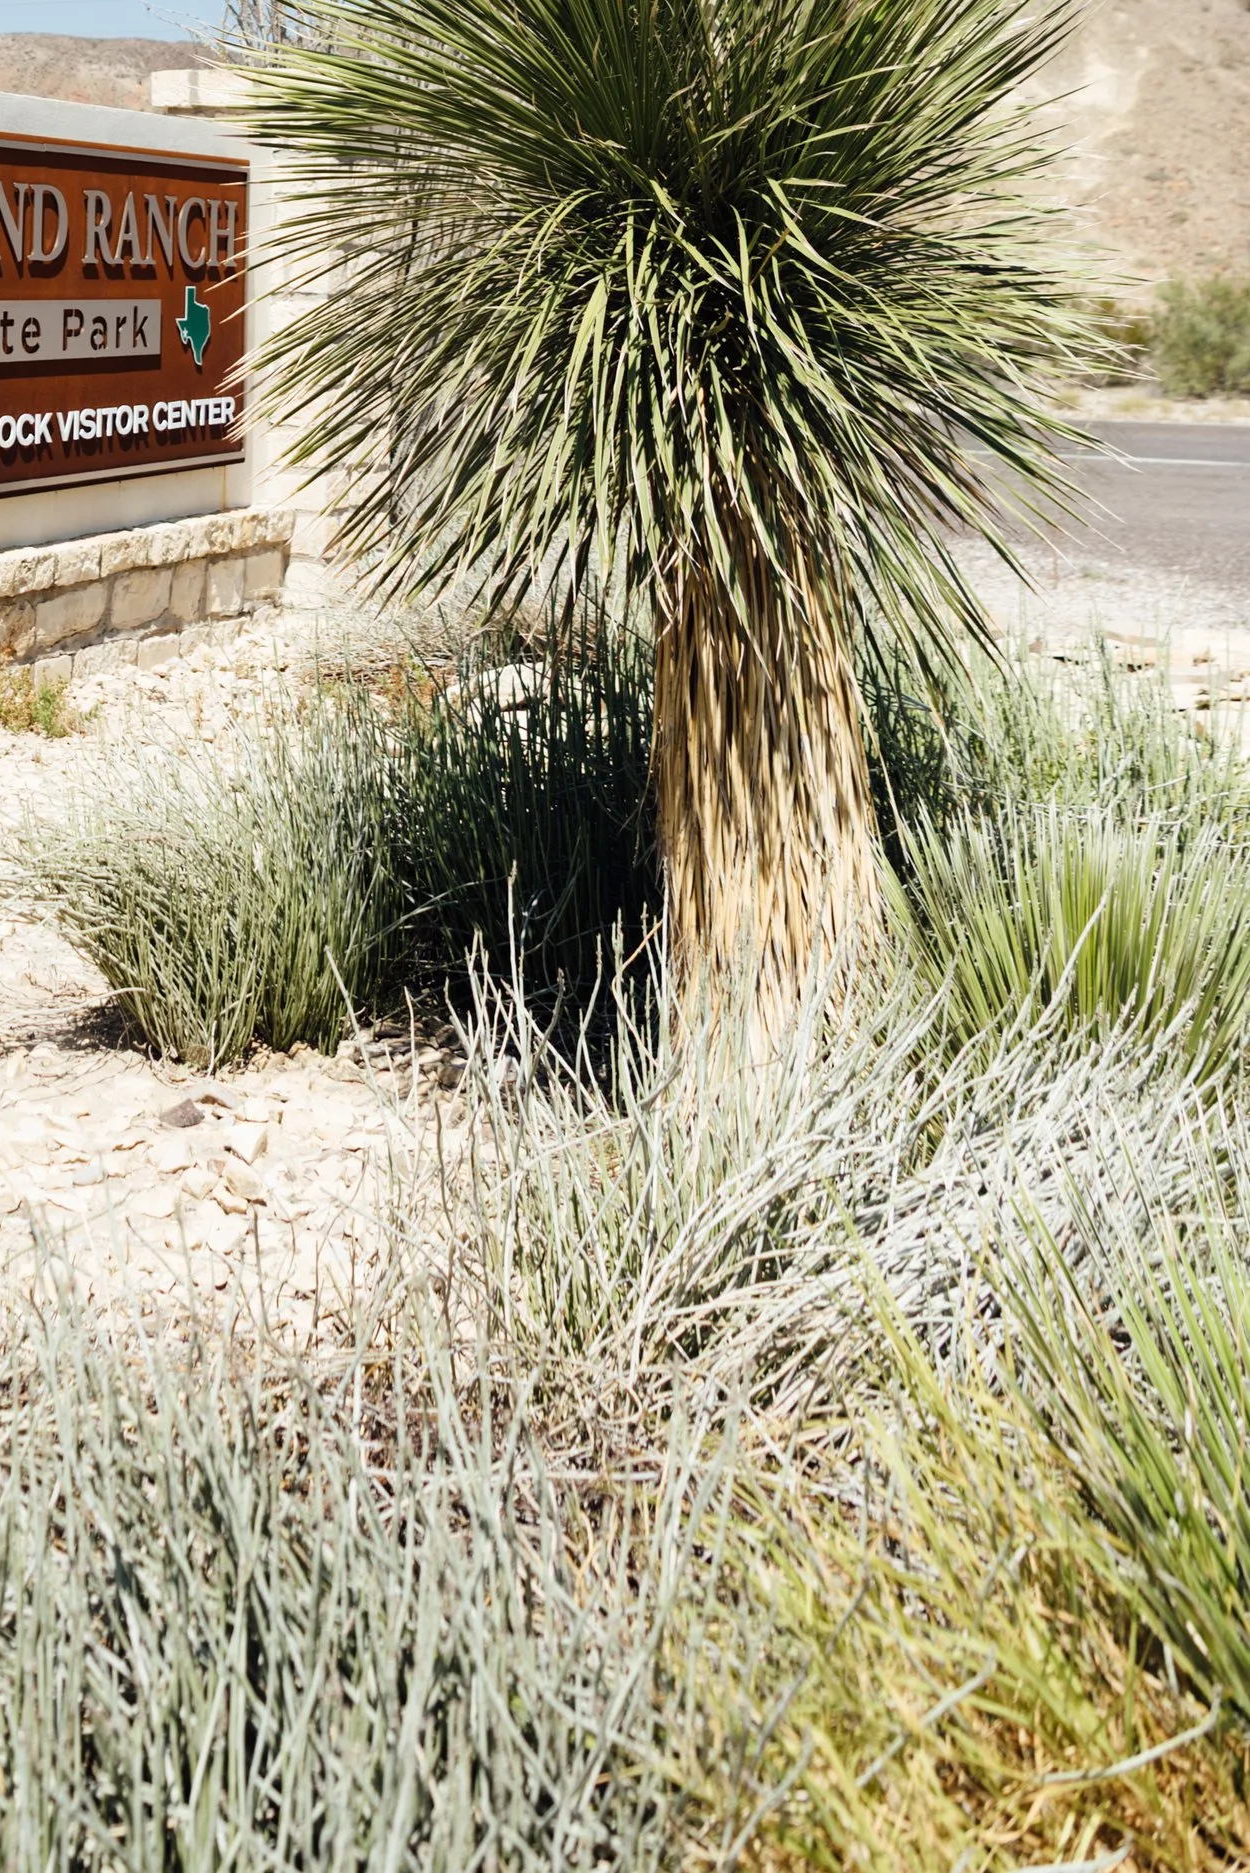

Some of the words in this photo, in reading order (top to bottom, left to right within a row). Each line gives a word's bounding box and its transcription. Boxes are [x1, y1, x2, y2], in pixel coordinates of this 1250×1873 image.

[81, 189, 239, 268] RANCH
[62, 305, 149, 352] Park
[56, 404, 149, 443] VISITOR
[152, 396, 237, 432] CENTER
